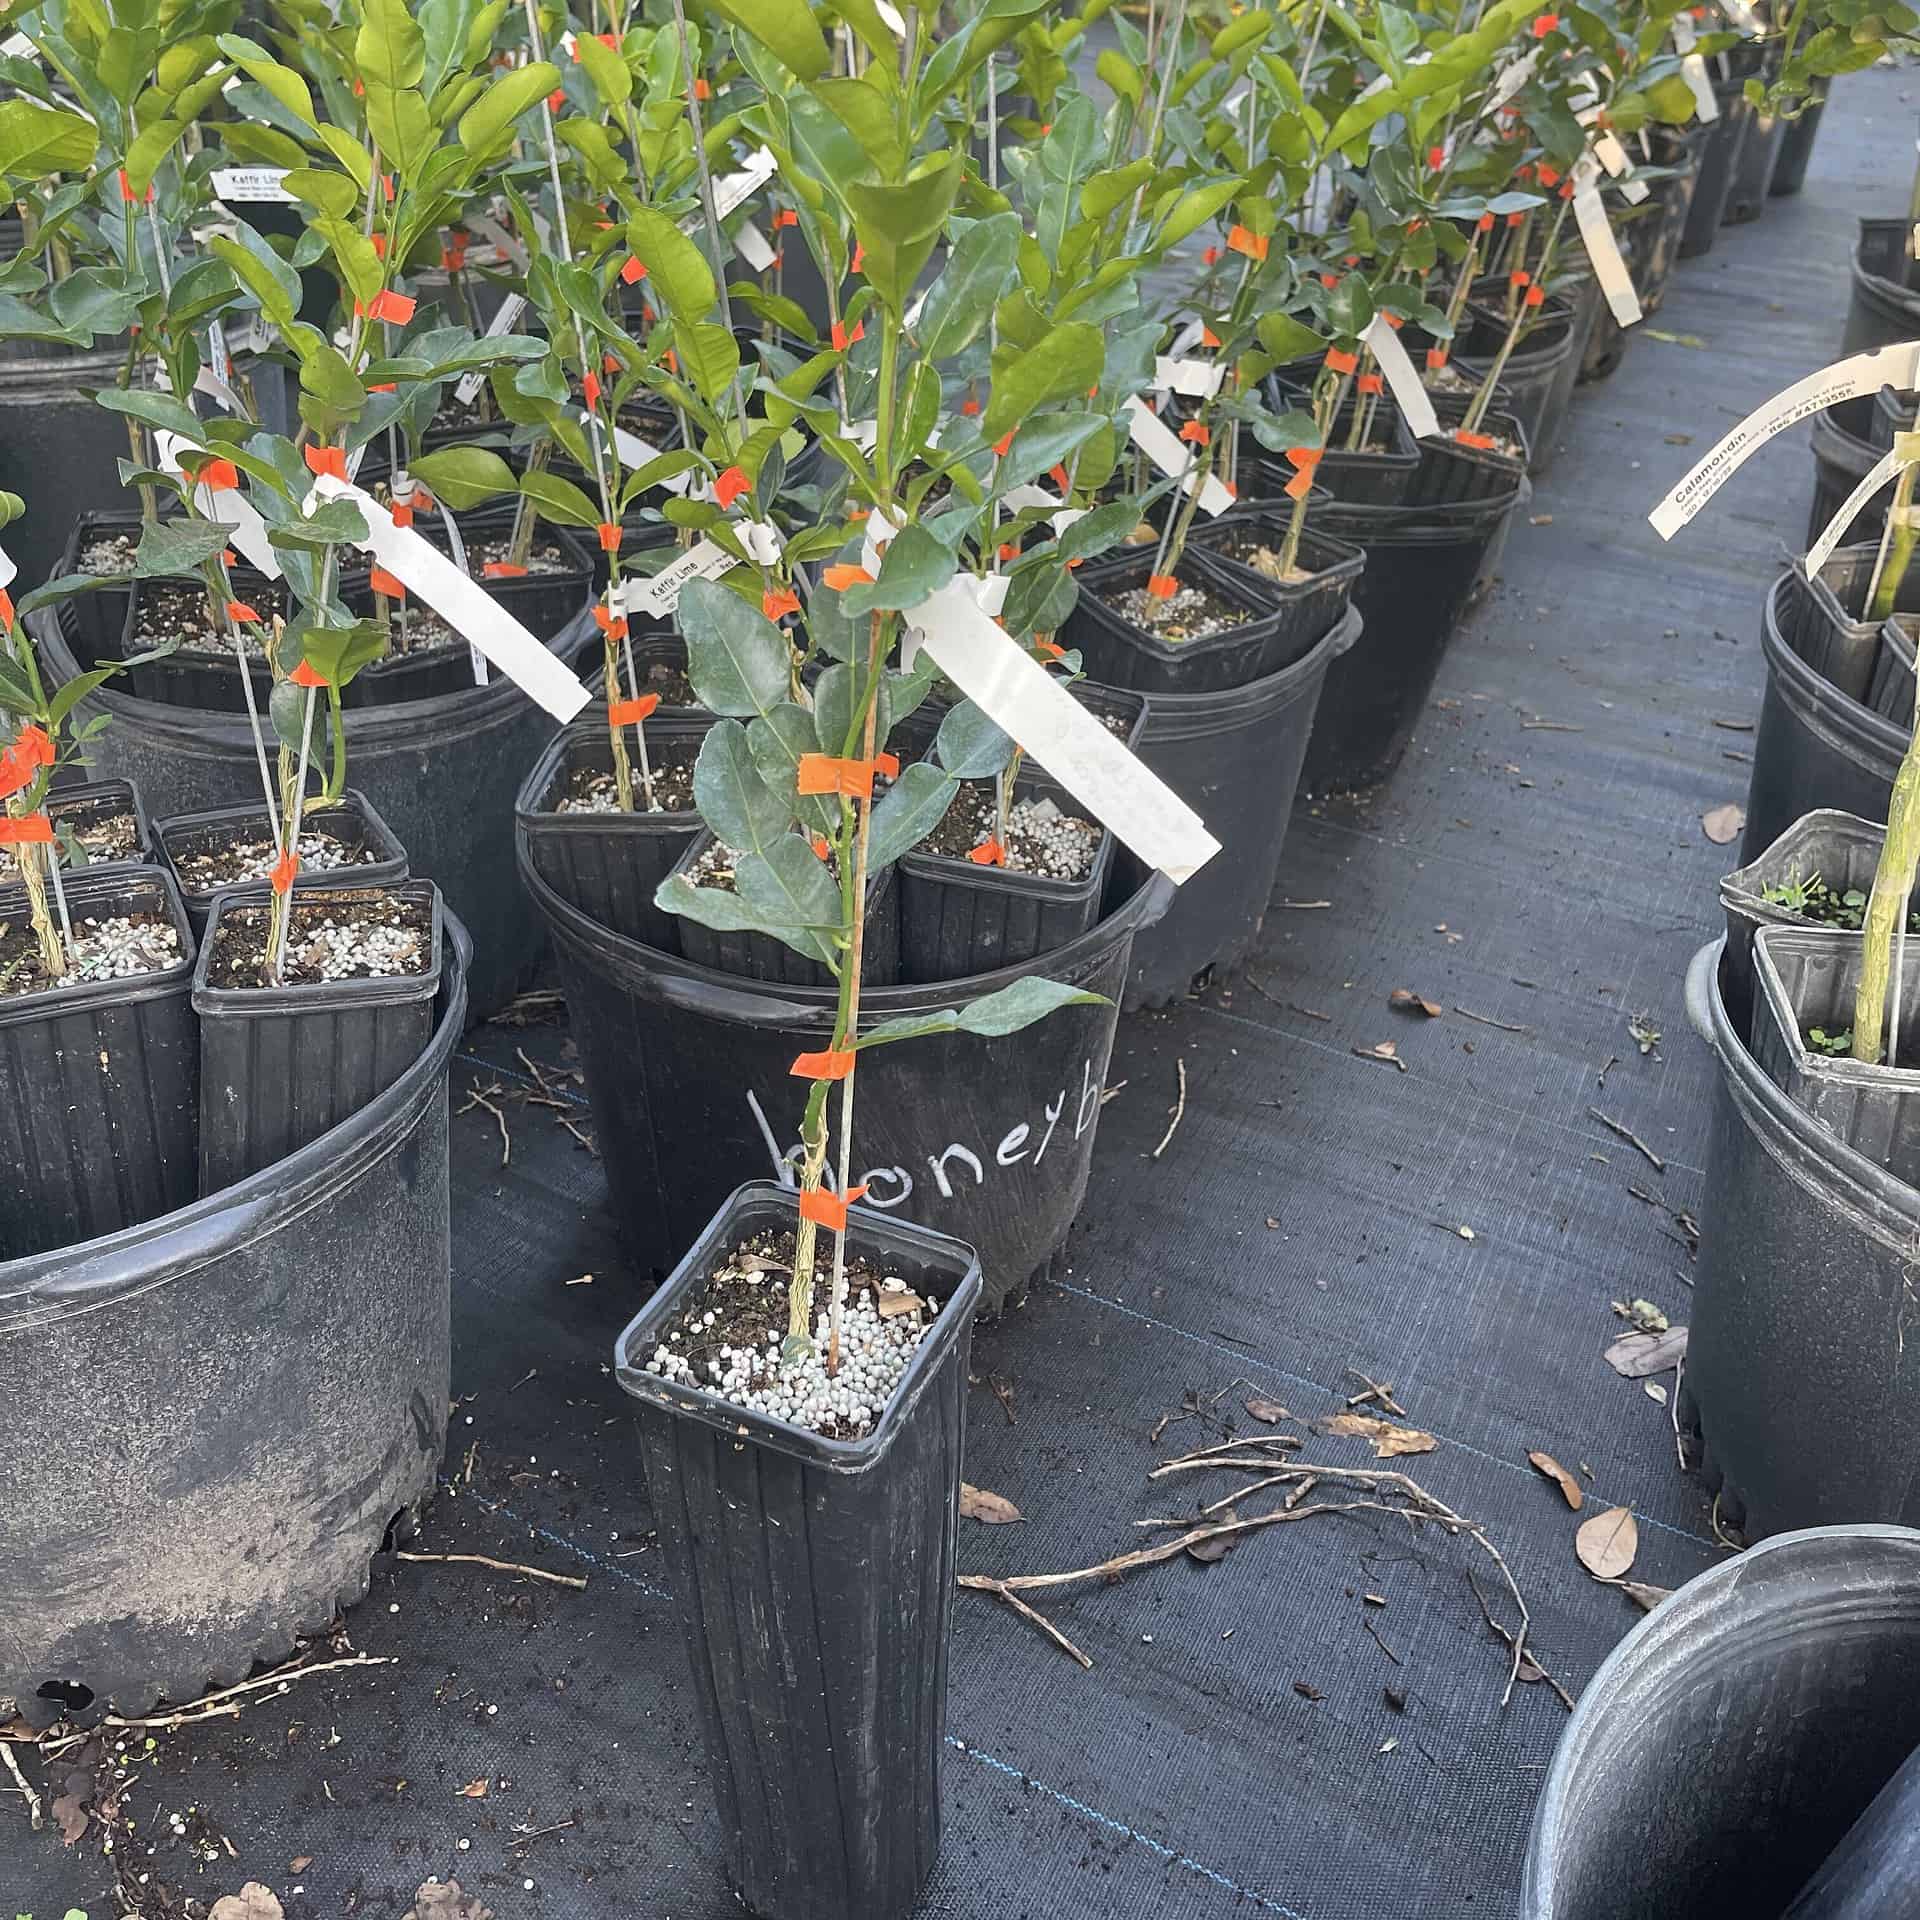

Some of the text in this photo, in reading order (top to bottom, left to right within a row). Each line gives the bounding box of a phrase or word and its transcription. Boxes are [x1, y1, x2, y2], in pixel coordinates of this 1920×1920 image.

[263, 174, 281, 185] Lim
[1674, 431, 1747, 504] Calamondin
[650, 577, 677, 599] Kaffir
[675, 561, 699, 580] Lime
